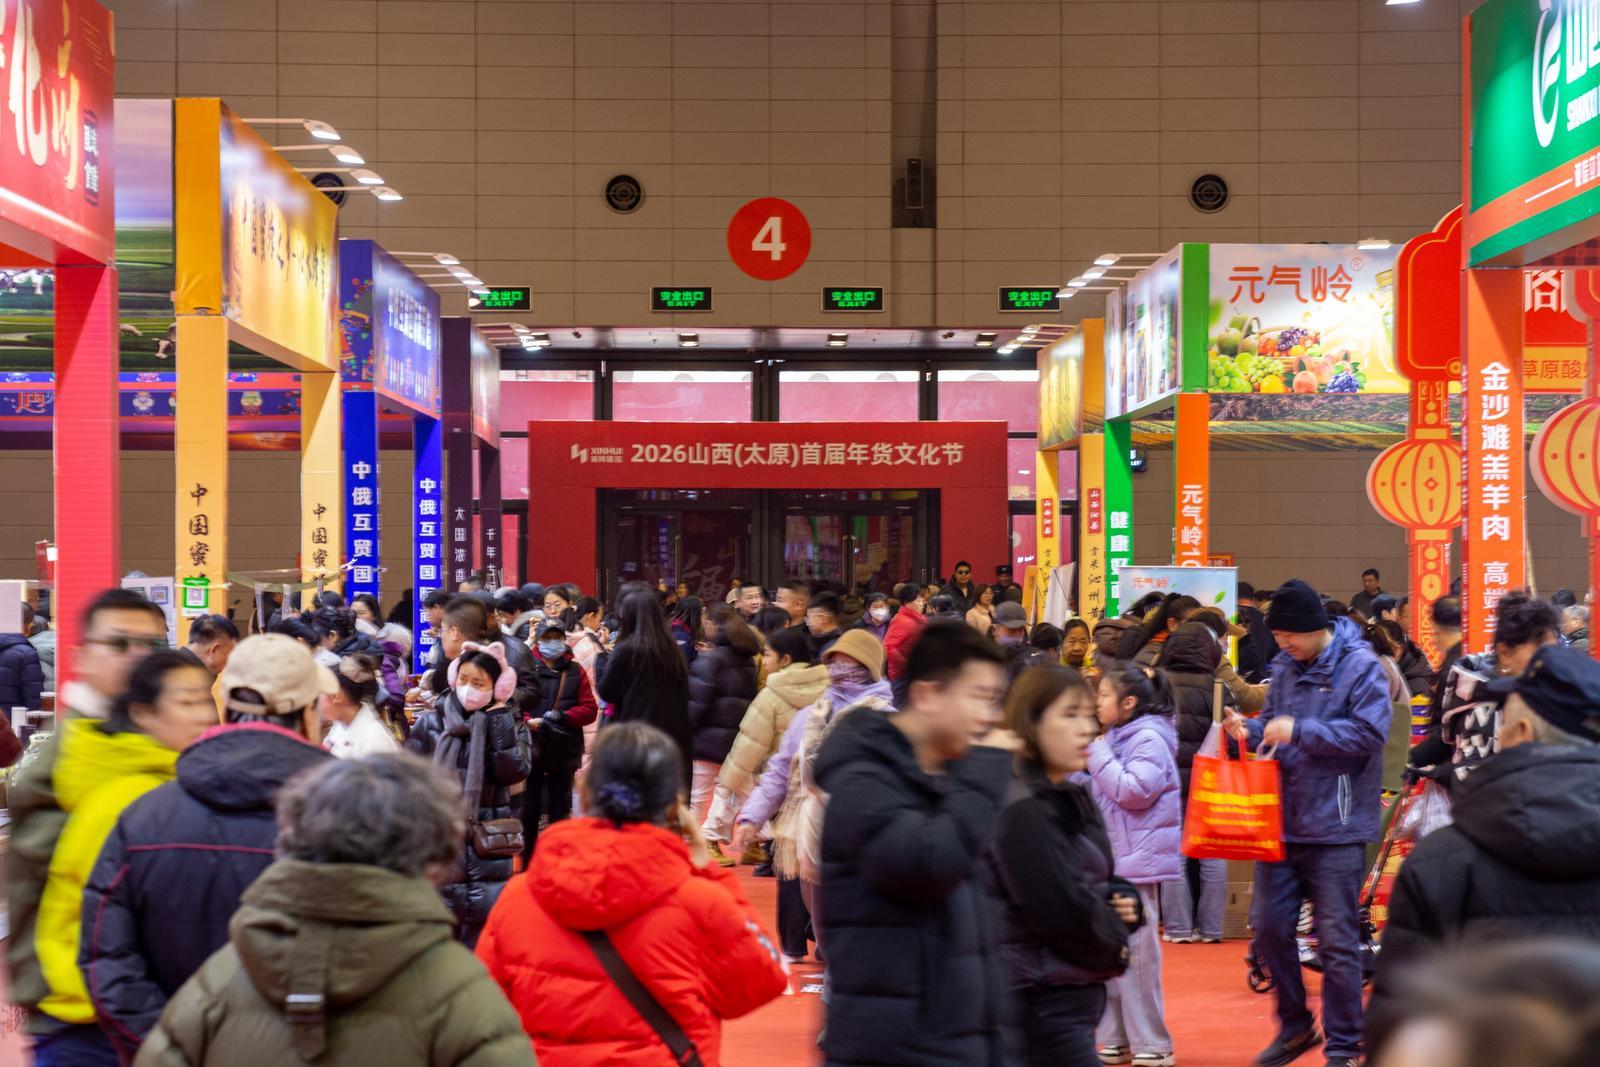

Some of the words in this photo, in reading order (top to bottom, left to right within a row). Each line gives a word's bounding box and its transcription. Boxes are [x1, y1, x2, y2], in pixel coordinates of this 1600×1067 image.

[752, 216, 787, 261] 4
[1228, 263, 1353, 304] 元气岭
[660, 291, 705, 302] 安全出口
[831, 291, 876, 302] 安全出口
[1007, 291, 1053, 302] 安全出口
[1523, 360, 1589, 379] 草原酸
[630, 442, 965, 468] 2026山西(太原)首届年货文化节
[1480, 362, 1511, 541] 金沙滩羔羊肉
[352, 461, 374, 600] 中俄互贸国
[1132, 576, 1169, 589] 元气岭
